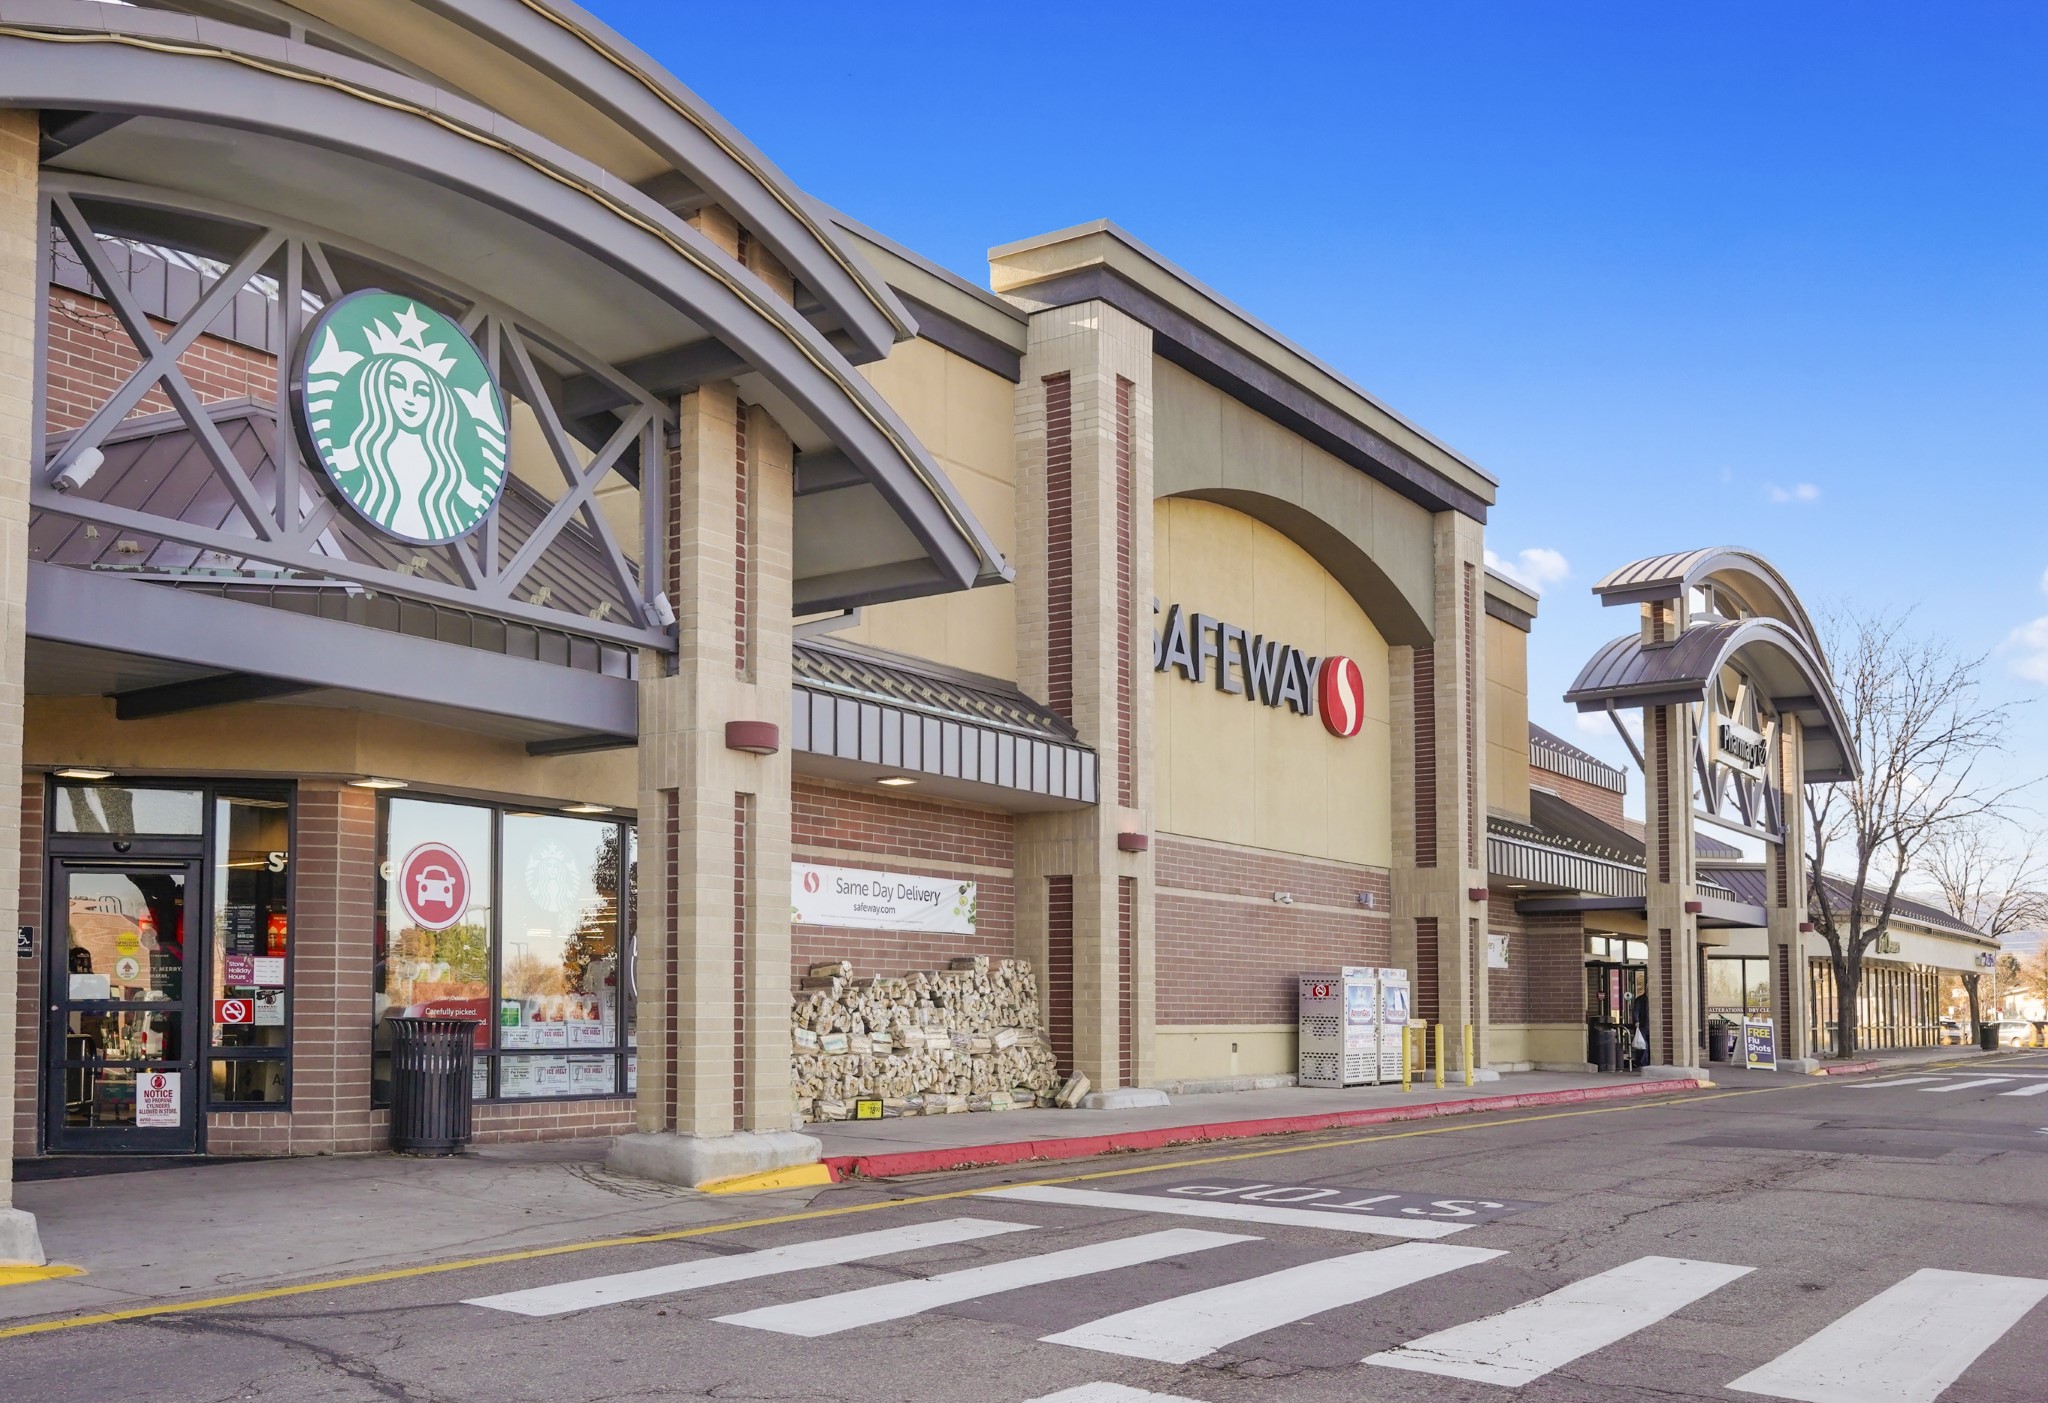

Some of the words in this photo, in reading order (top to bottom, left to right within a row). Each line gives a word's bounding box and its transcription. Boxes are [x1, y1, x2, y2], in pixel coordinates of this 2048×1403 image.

[836, 877, 869, 897] Same
[872, 881, 894, 902] Day
[897, 884, 941, 906] Delivery
[853, 902, 896, 915] safeway.com
[228, 967, 252, 975] Holiday
[425, 1007, 454, 1017] Carefully
[455, 1008, 478, 1017] picked.
[1747, 1028, 1770, 1038] FREE
[1747, 1036, 1760, 1045] Flu
[1748, 1044, 1771, 1052] Shots
[144, 1089, 173, 1098] NOTICE
[1166, 1184, 1504, 1216] STOP
